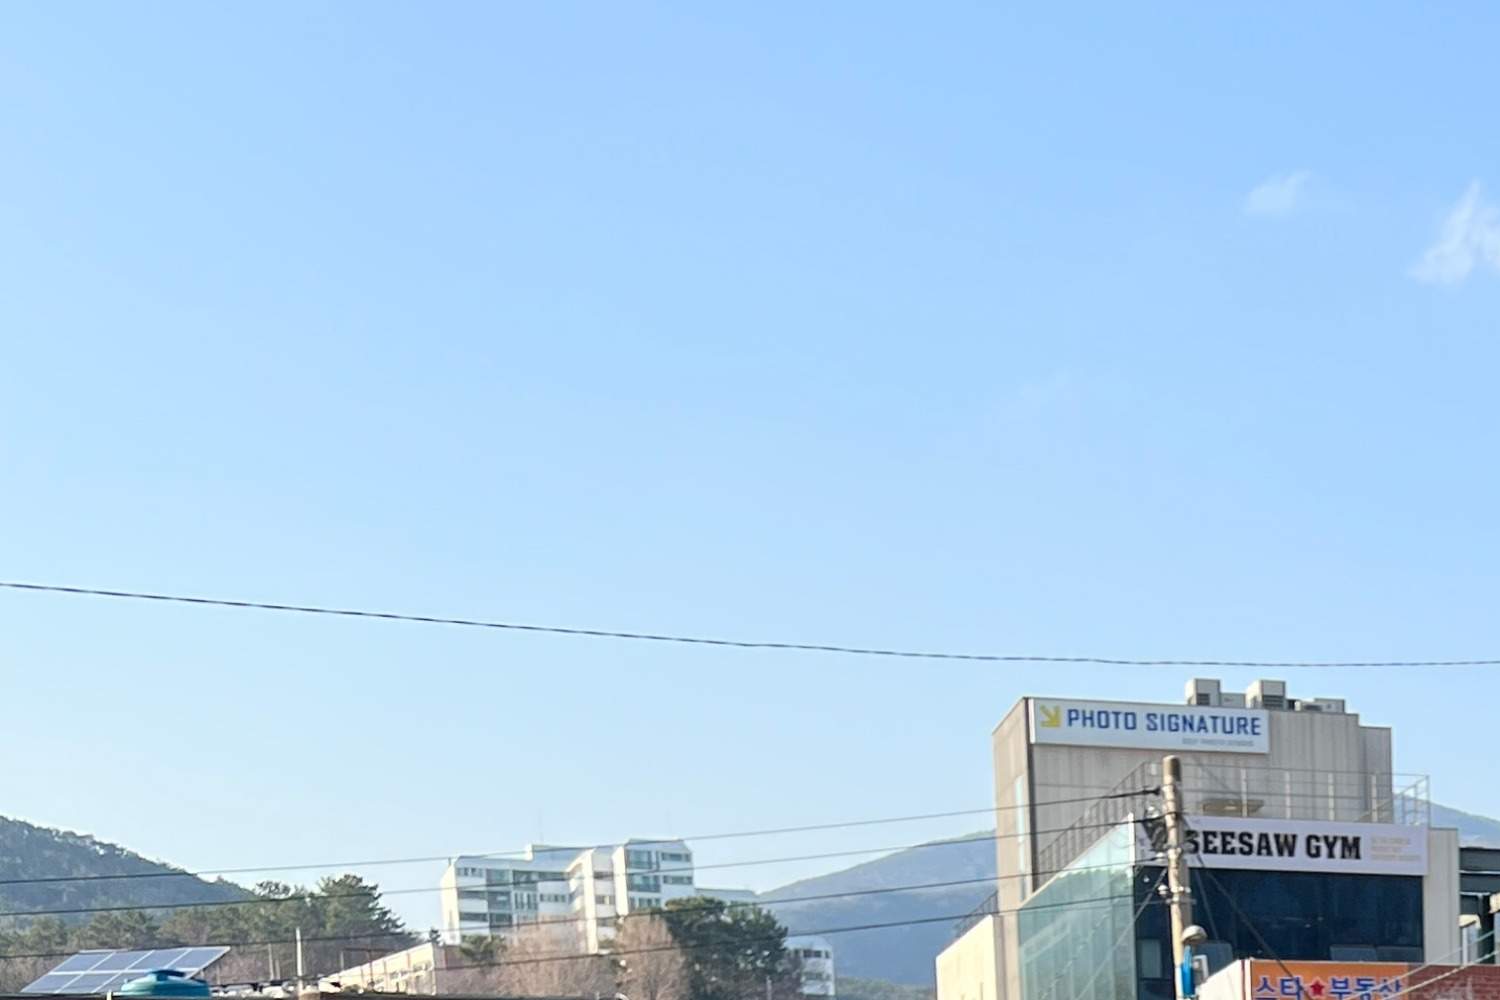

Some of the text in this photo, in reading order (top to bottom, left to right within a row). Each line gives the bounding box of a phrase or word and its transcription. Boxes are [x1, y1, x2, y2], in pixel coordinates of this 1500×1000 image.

[1066, 708, 1262, 736] PHOTO SIGNATURE
[1185, 829, 1298, 857] SEESAW
[1305, 834, 1363, 860] GYM
